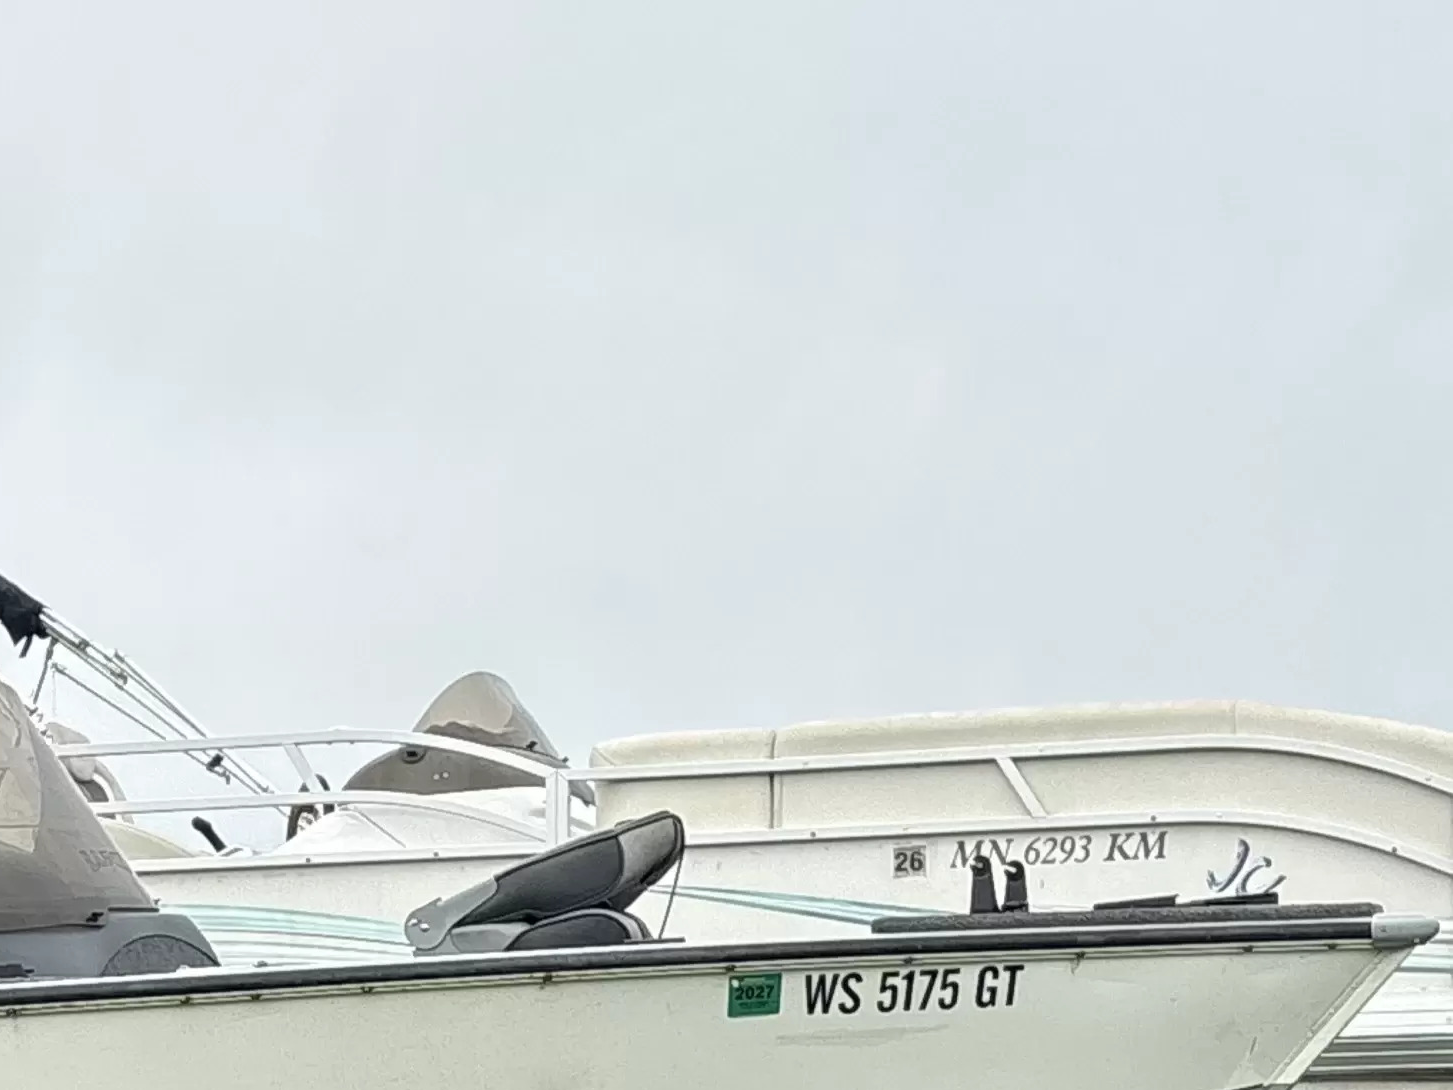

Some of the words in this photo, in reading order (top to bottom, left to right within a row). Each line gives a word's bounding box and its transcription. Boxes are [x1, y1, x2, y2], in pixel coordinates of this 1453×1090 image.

[896, 851, 924, 872] 26
[949, 839, 1014, 869] MN
[1023, 835, 1093, 866] 6293
[1103, 830, 1168, 861] KM
[734, 984, 775, 1001] 2027
[805, 972, 863, 1015] WS
[877, 968, 961, 1013] 5175
[975, 964, 1025, 1008] GT
